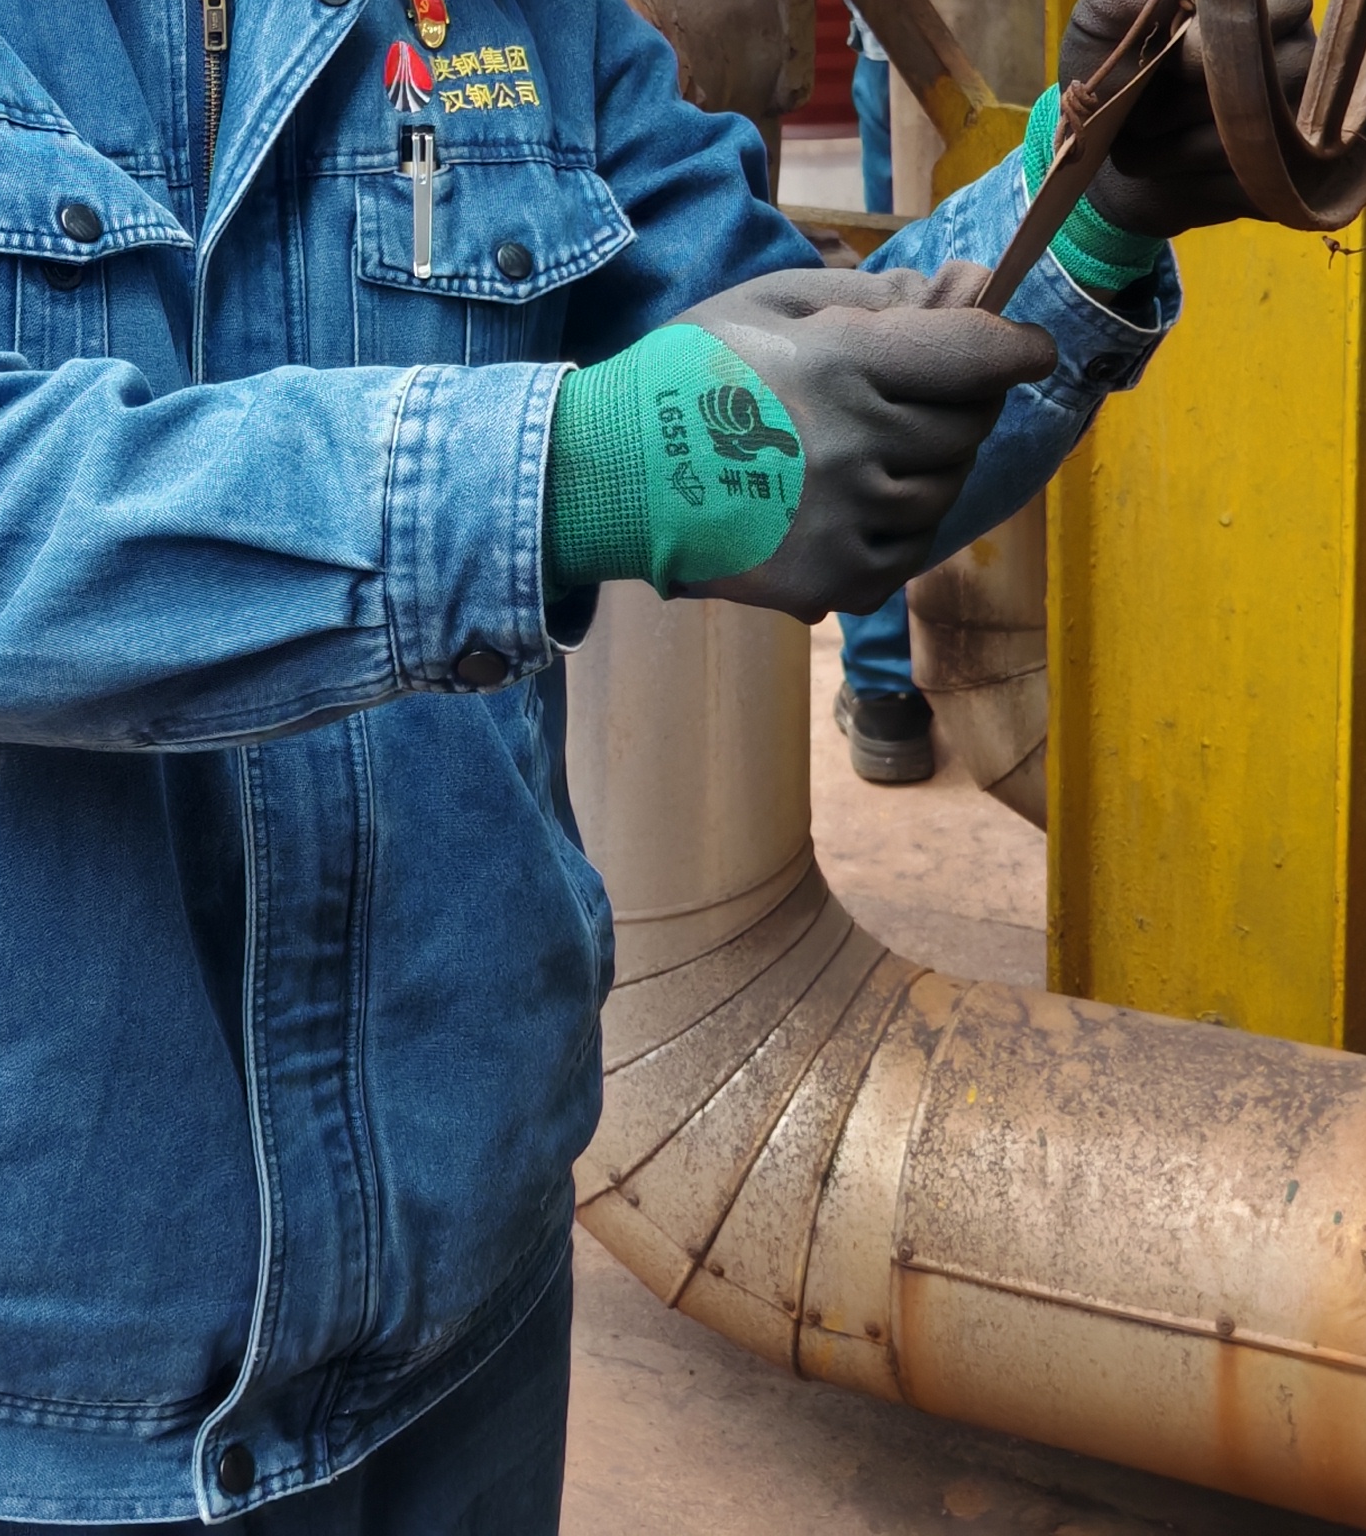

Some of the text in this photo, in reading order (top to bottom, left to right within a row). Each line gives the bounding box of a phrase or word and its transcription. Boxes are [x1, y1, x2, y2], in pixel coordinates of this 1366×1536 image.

[429, 45, 529, 82] 陕钢集团
[438, 80, 540, 113] 汉钢公司
